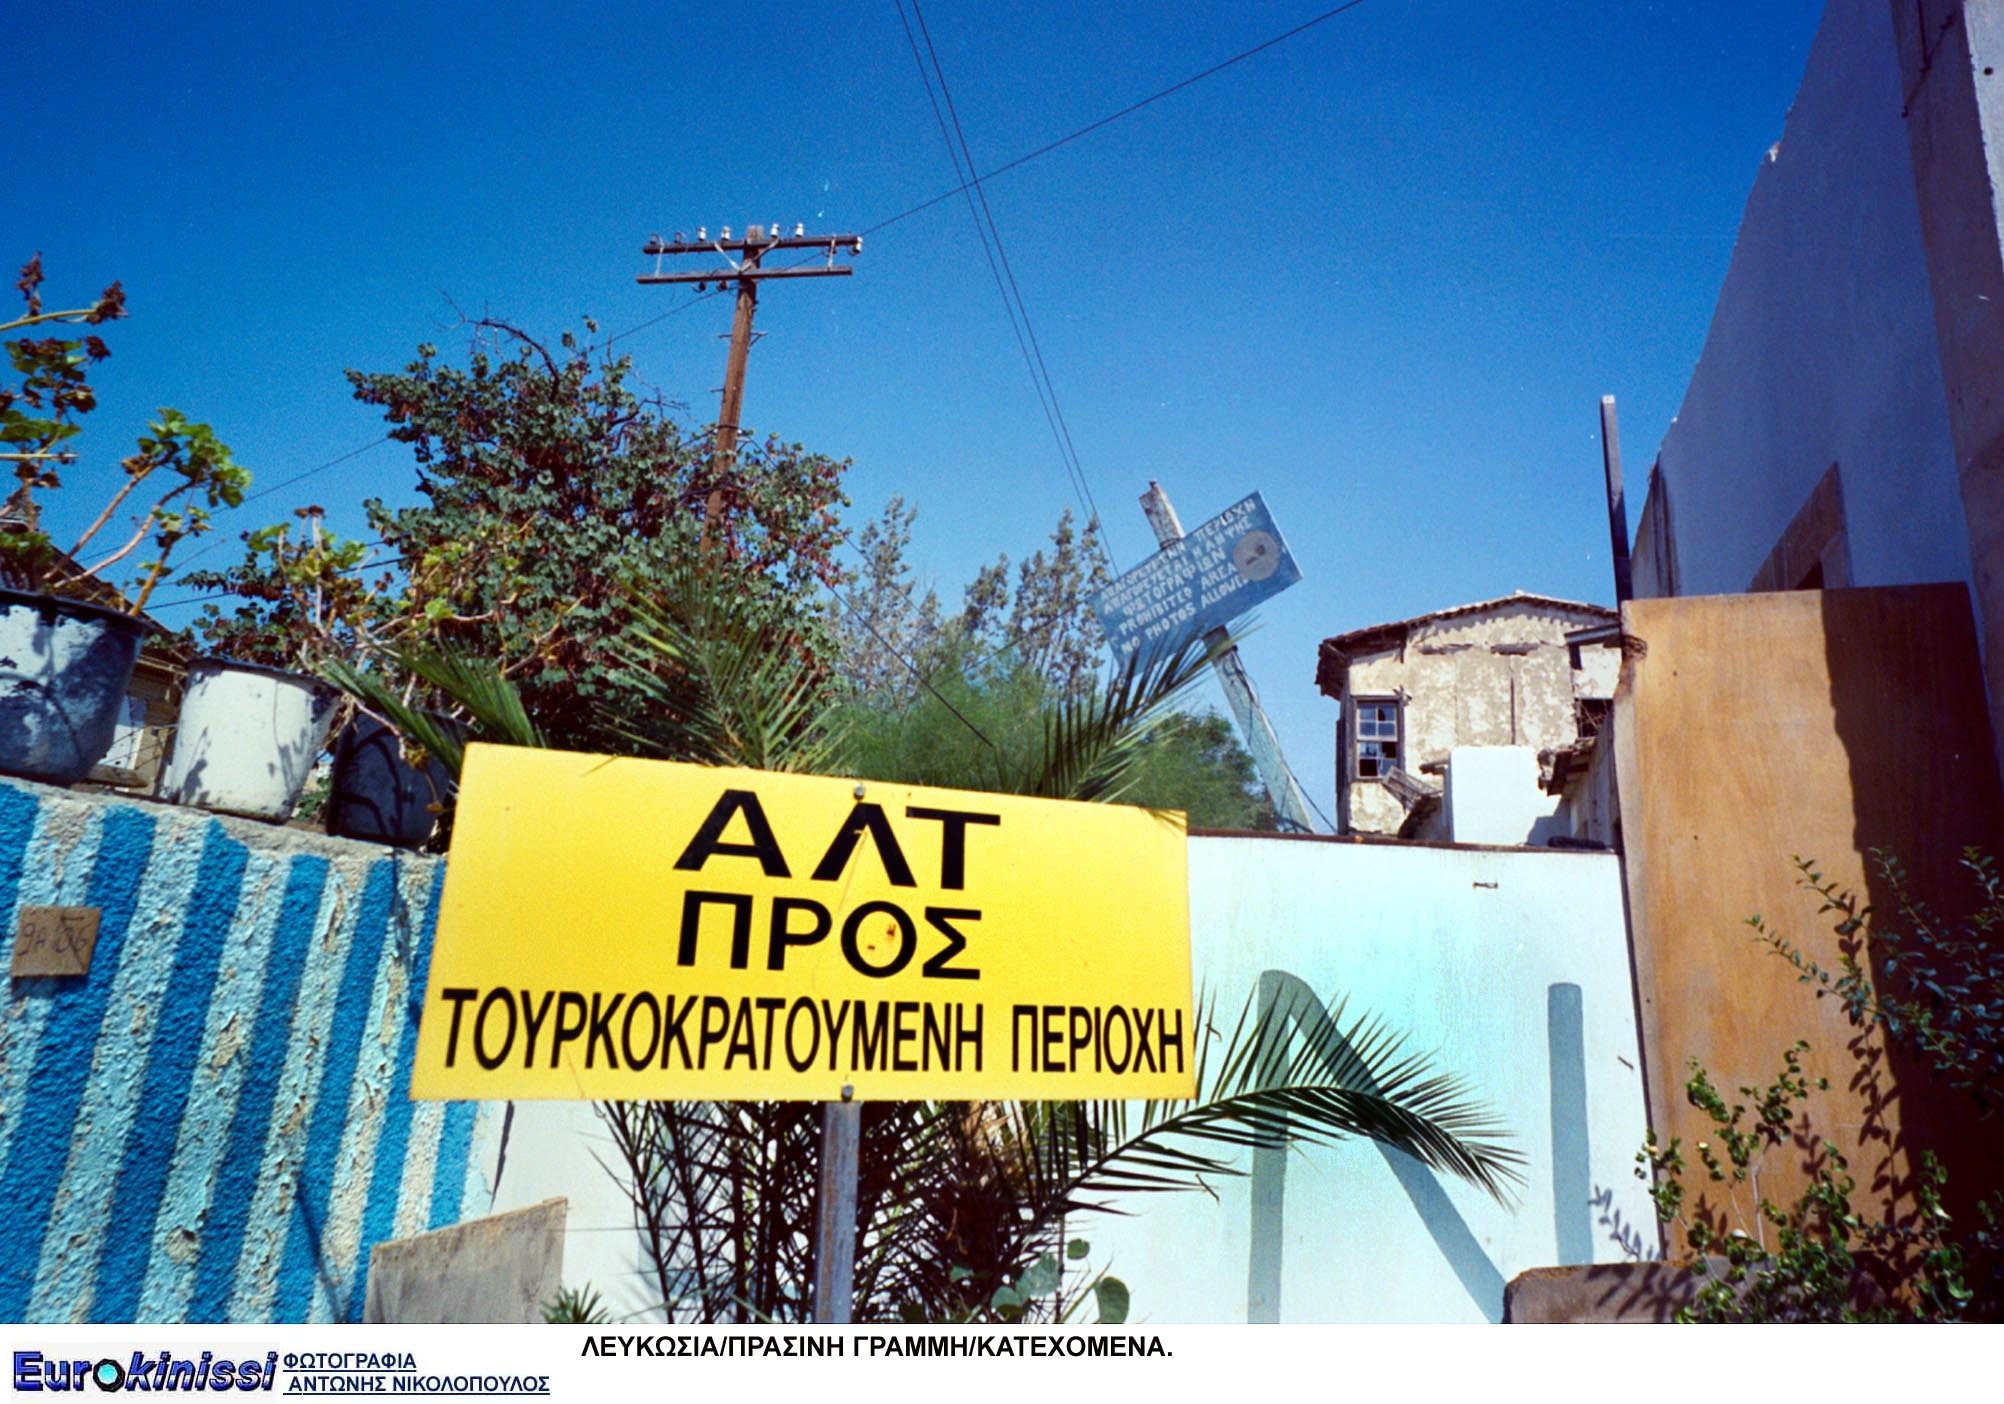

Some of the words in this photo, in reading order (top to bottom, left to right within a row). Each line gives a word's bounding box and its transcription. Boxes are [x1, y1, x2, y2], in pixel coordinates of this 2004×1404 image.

[1120, 587, 1192, 636] PROHIBITED
[1201, 562, 1237, 591] AREA
[1123, 547, 1226, 616] ΦΩΤΟΓΡΑΦΙΩΝ
[1121, 636, 1141, 654] NO
[1144, 603, 1196, 640] PHOTOS
[673, 789, 1001, 890] ΑΛΤ
[677, 890, 982, 980] ΠΡΟΣ
[442, 986, 983, 1073] ΤΟΥΡΚΟΚΡΑΤΟΥΜΕΝΗ
[1013, 1005, 1184, 1074] ΠΕΡΙΟΧΗ
